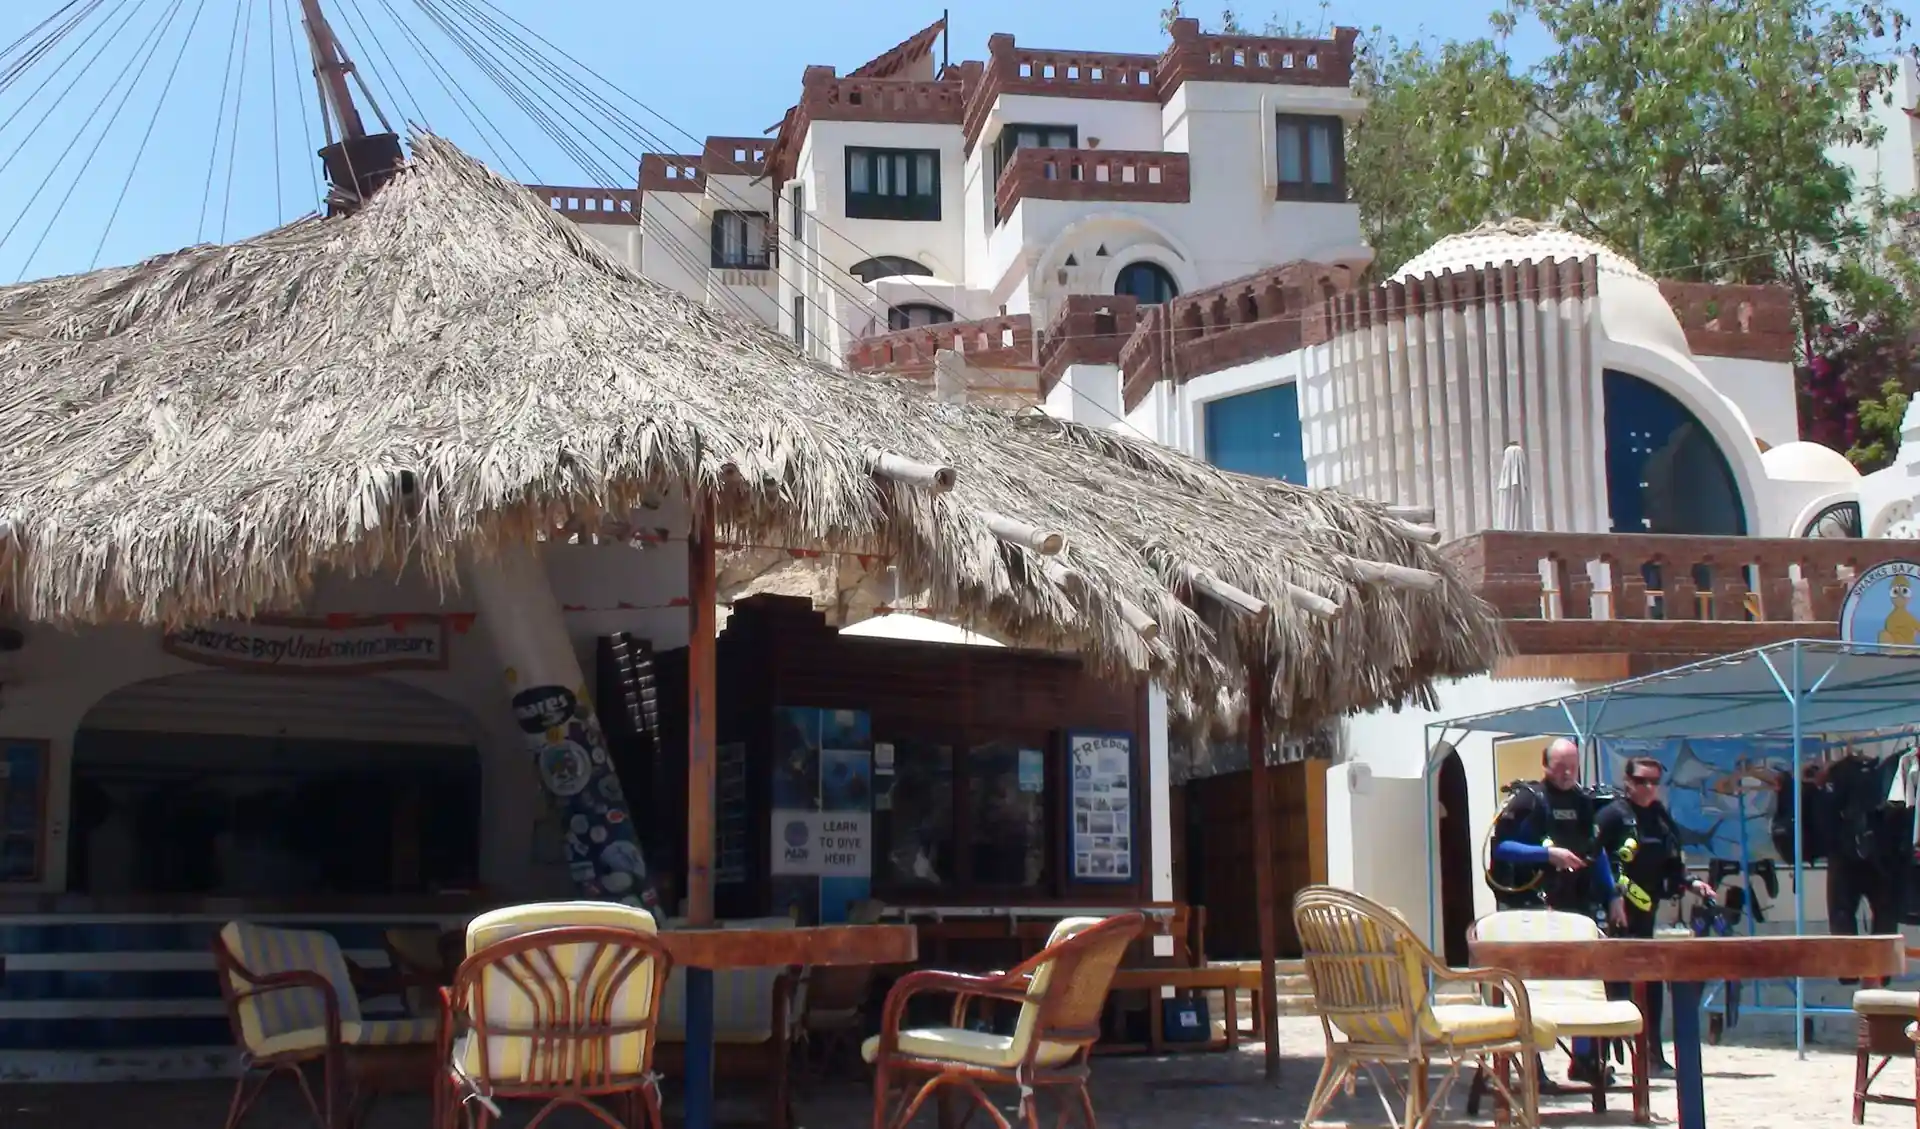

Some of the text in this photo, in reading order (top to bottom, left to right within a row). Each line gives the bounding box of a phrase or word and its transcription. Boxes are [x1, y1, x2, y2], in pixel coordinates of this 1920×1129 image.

[1853, 567, 1888, 596] SHARKS
[1891, 564, 1914, 575] BAY
[1073, 738, 1129, 765] FREEDOM
[823, 820, 858, 833] LEARN
[819, 836, 862, 850] TO DIVE
[824, 852, 857, 867] HERE!
